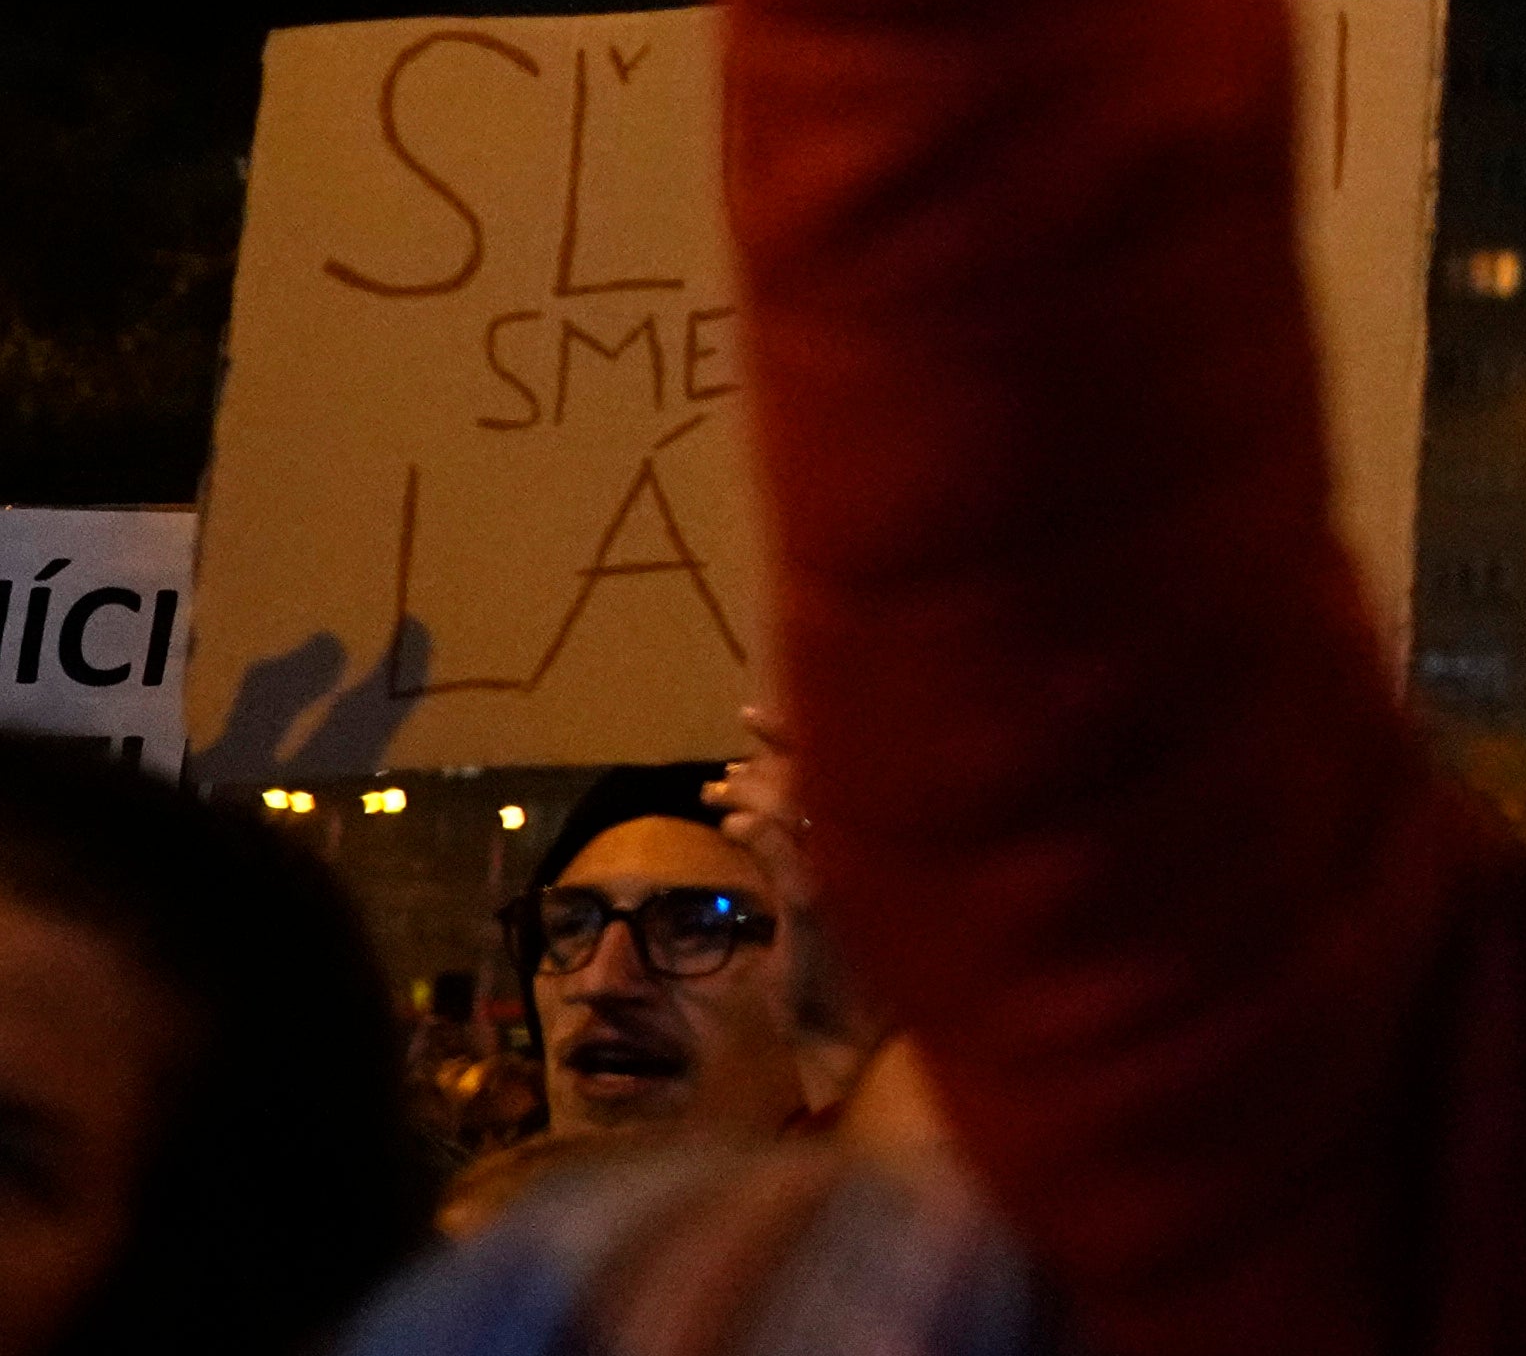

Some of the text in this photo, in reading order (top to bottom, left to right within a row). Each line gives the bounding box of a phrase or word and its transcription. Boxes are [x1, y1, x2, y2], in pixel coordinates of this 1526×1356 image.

[477, 309, 742, 431] SME
[387, 412, 746, 701] LÁ
[0, 558, 178, 686] ÍCI
